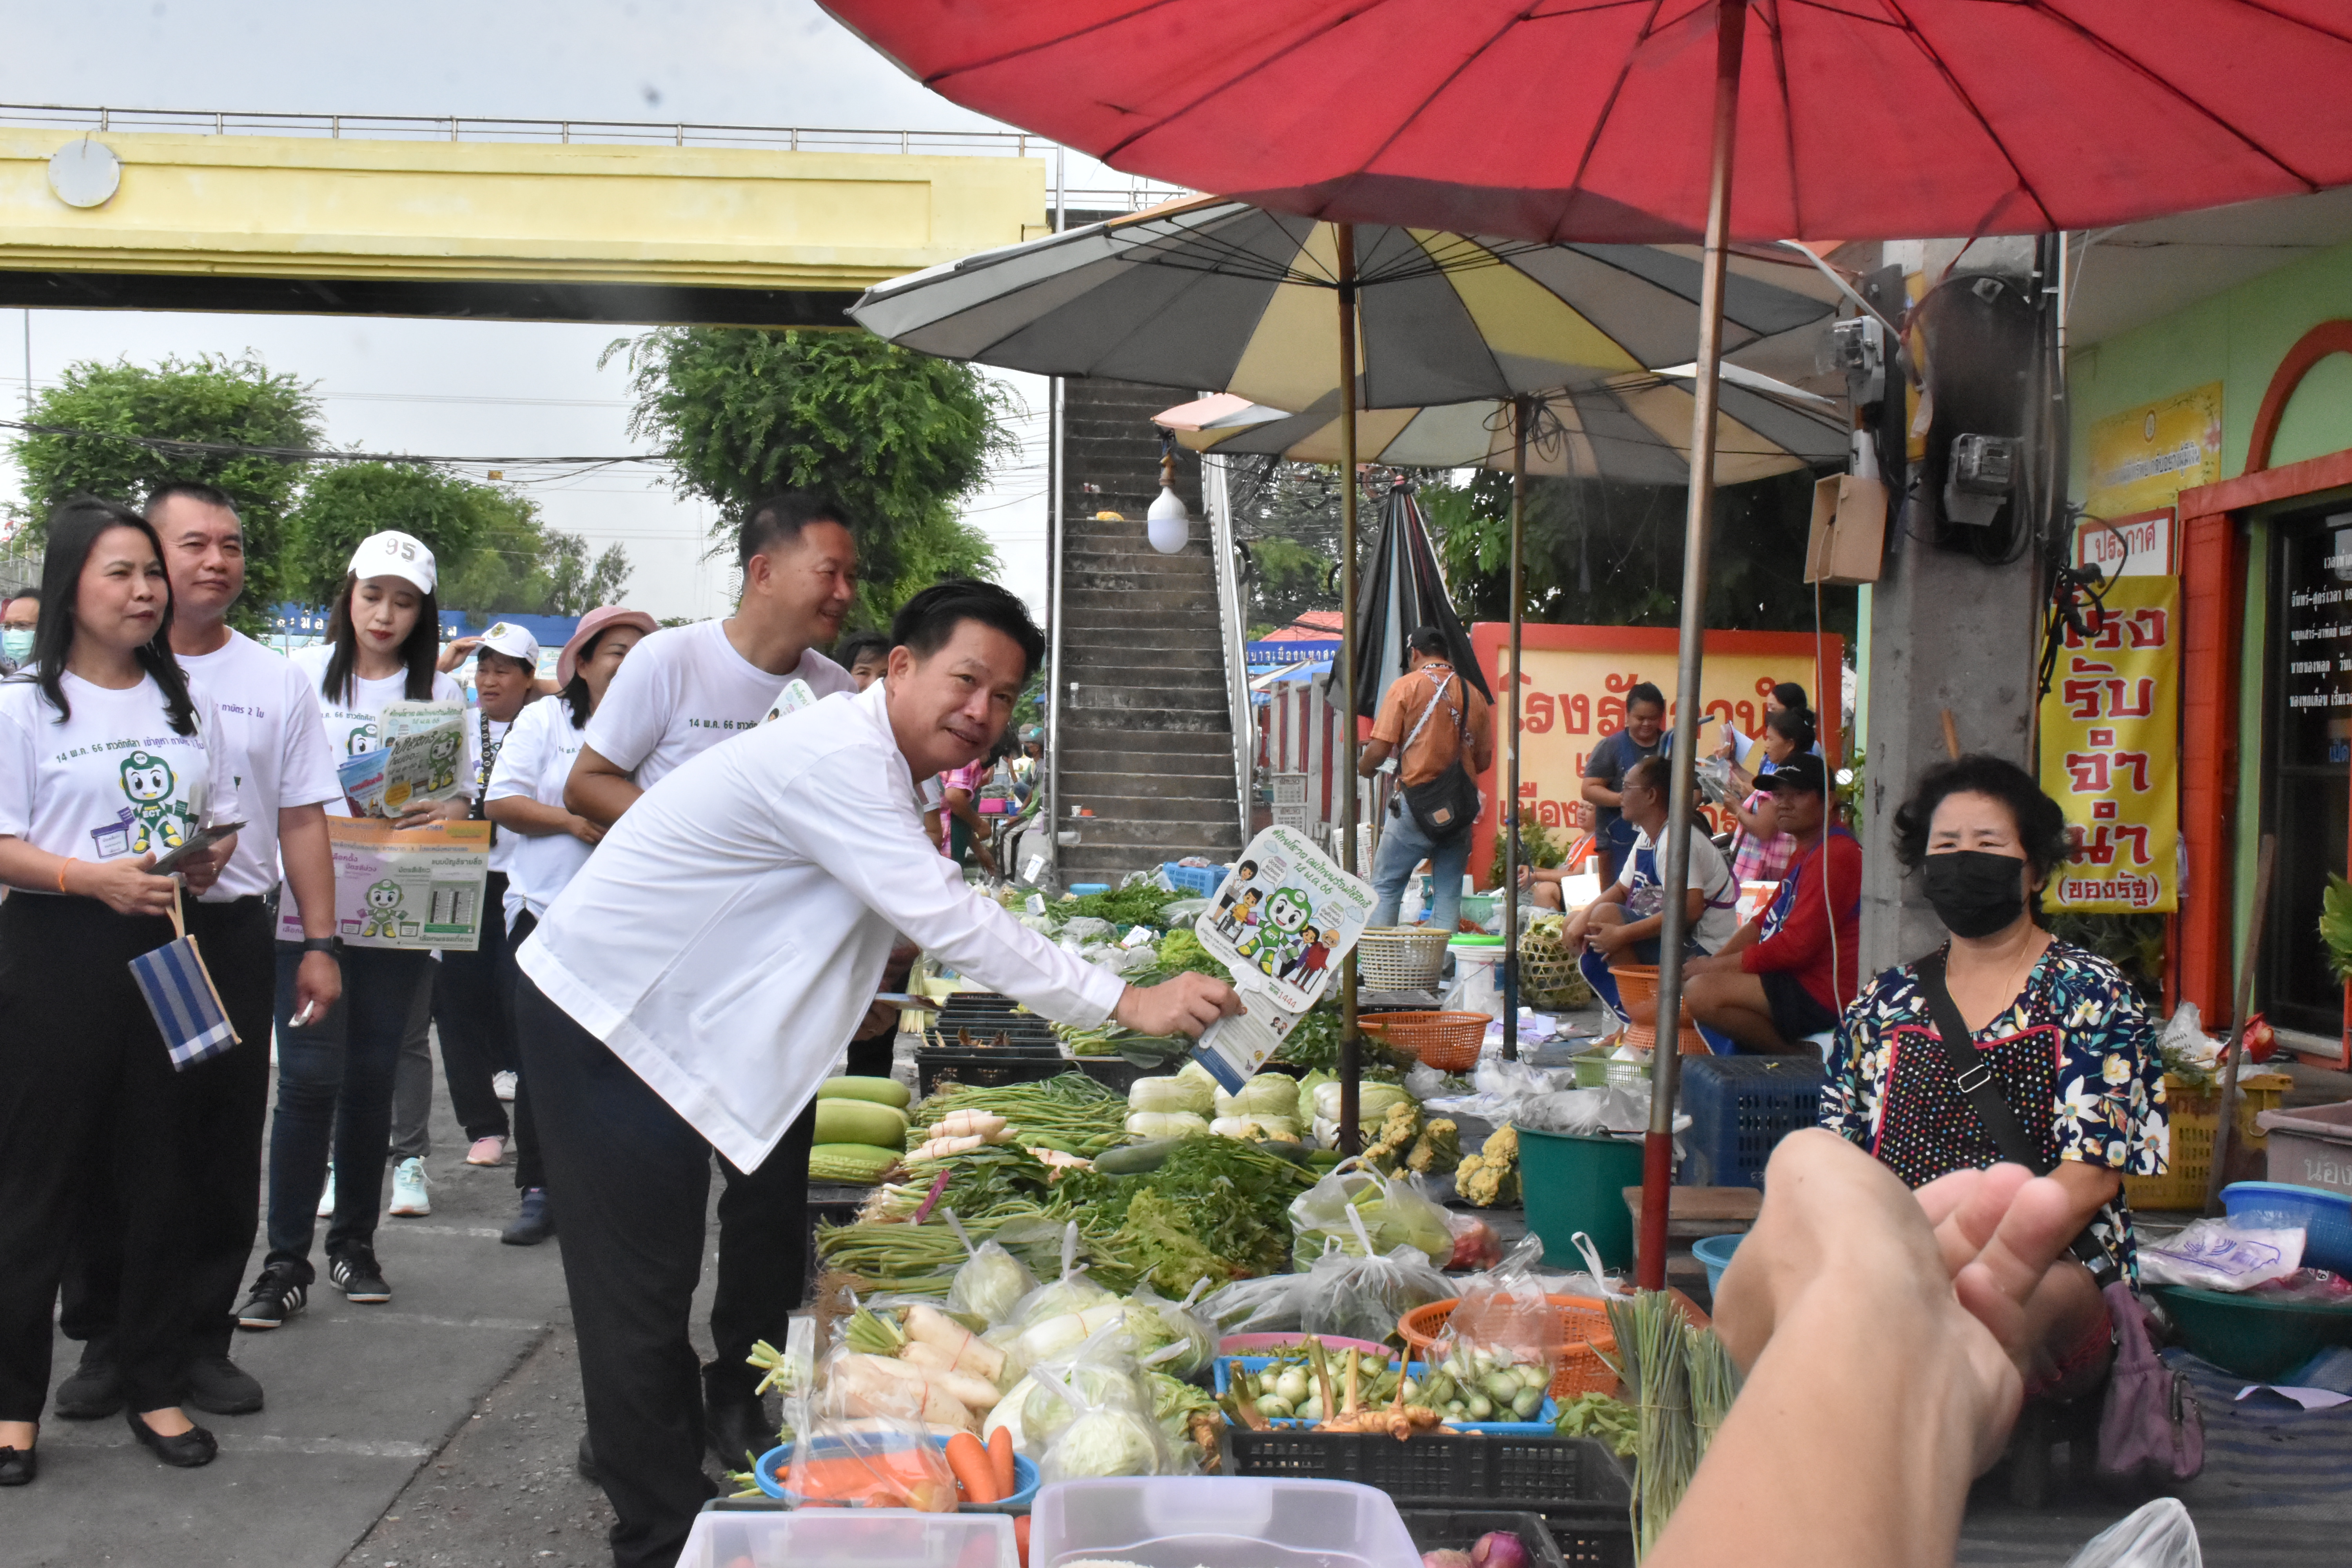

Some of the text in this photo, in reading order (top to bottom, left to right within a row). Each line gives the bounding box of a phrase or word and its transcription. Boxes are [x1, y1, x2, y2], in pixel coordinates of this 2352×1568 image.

[2095, 522, 2156, 563] ประกาศ
[2064, 657, 2154, 719] รับ
[248, 707, 252, 715] 2
[256, 707, 264, 718] ใบ
[689, 719, 699, 728] 14
[704, 720, 720, 729] พ.ค.
[724, 720, 733, 729] 66
[56, 753, 67, 763] 14
[70, 748, 89, 757] พ.ค.
[92, 744, 103, 753] 66
[2066, 729, 2151, 792] จำ
[142, 809, 161, 818] ECT
[2067, 802, 2152, 865] นำ
[1294, 862, 1307, 873] 14
[1319, 884, 1333, 895] 66
[2058, 873, 2159, 907] (ของรัฐ)
[1265, 929, 1278, 941] ECT
[1278, 991, 1298, 1009] 1444
